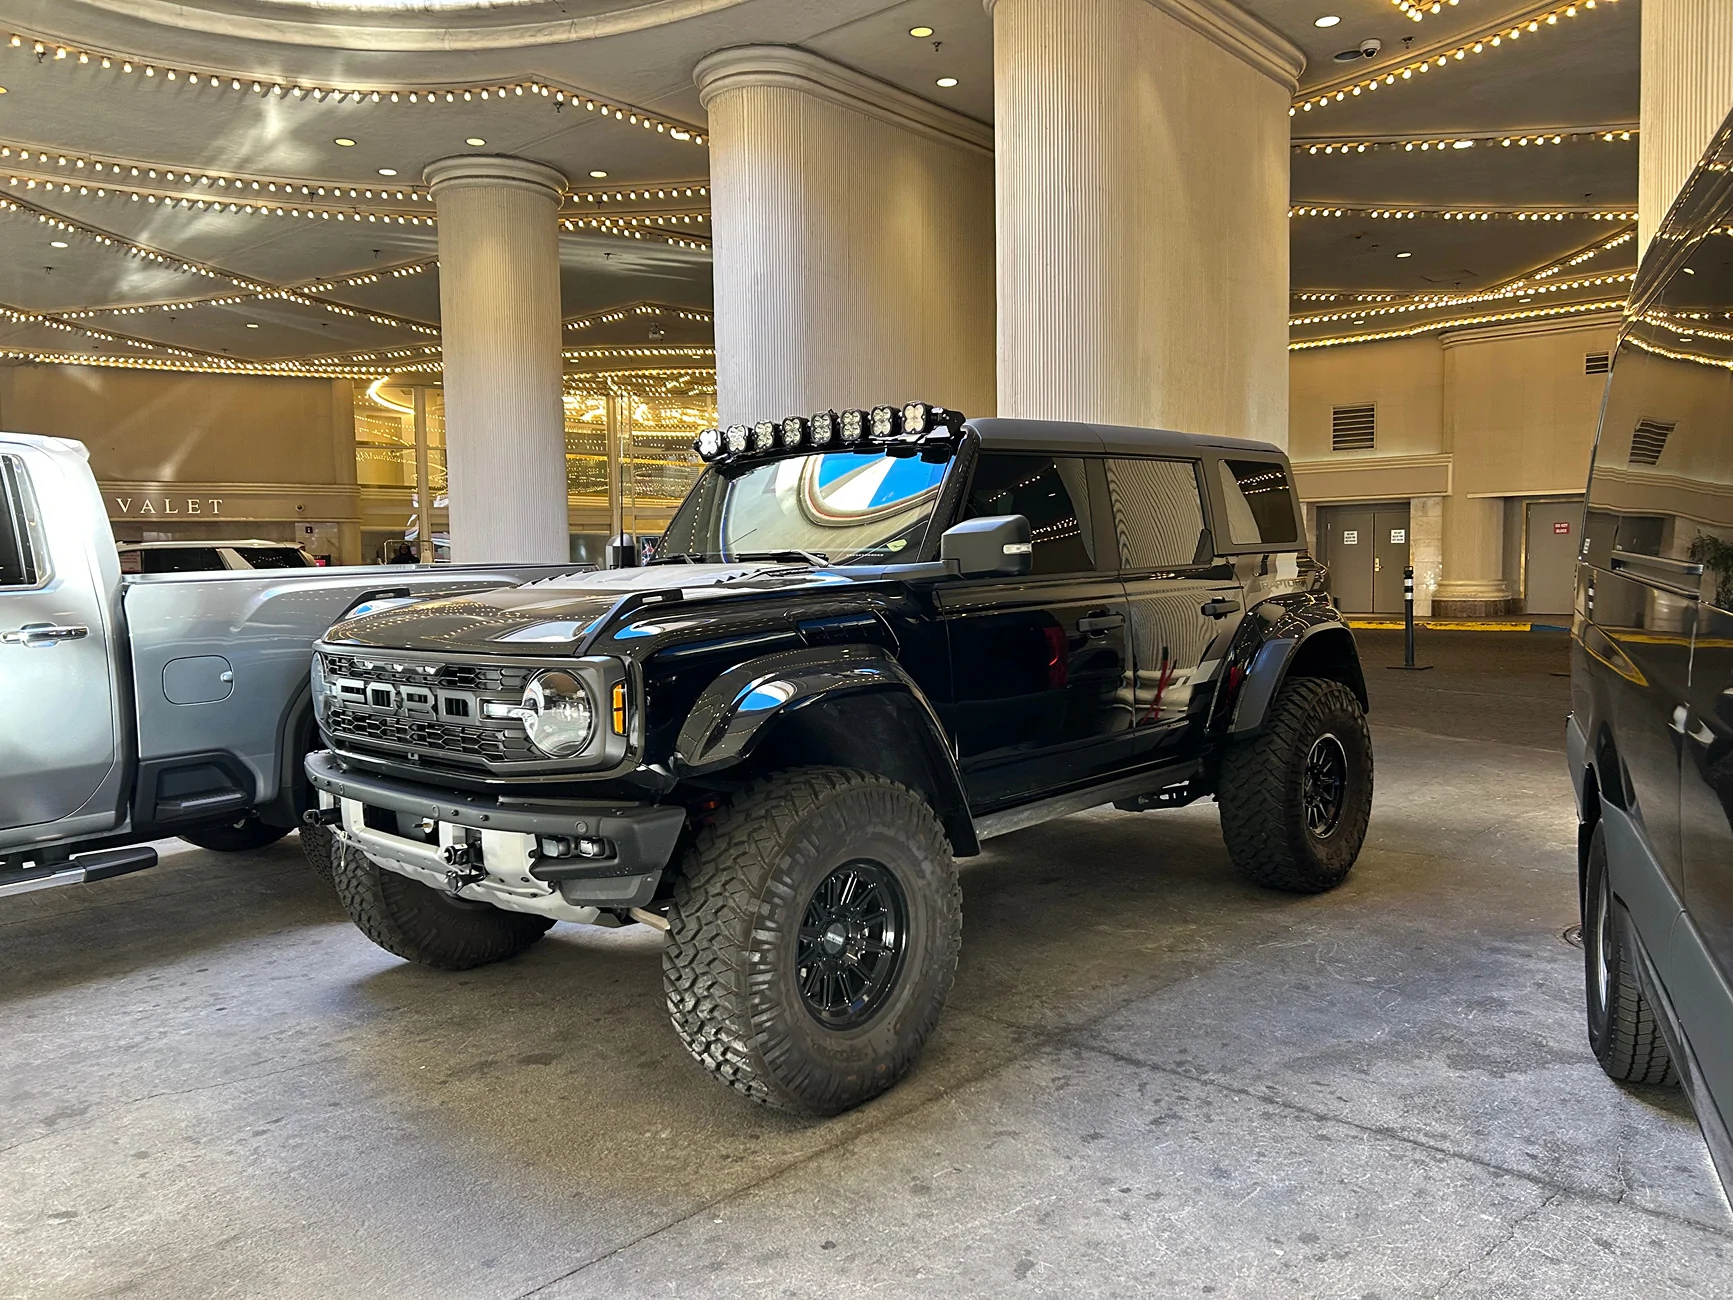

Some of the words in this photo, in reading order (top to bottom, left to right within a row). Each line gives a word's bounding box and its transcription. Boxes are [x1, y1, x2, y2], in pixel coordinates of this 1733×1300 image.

[115, 498, 223, 514] VALET
[1261, 579, 1305, 591] RAPTOR
[336, 678, 478, 726] FORD
